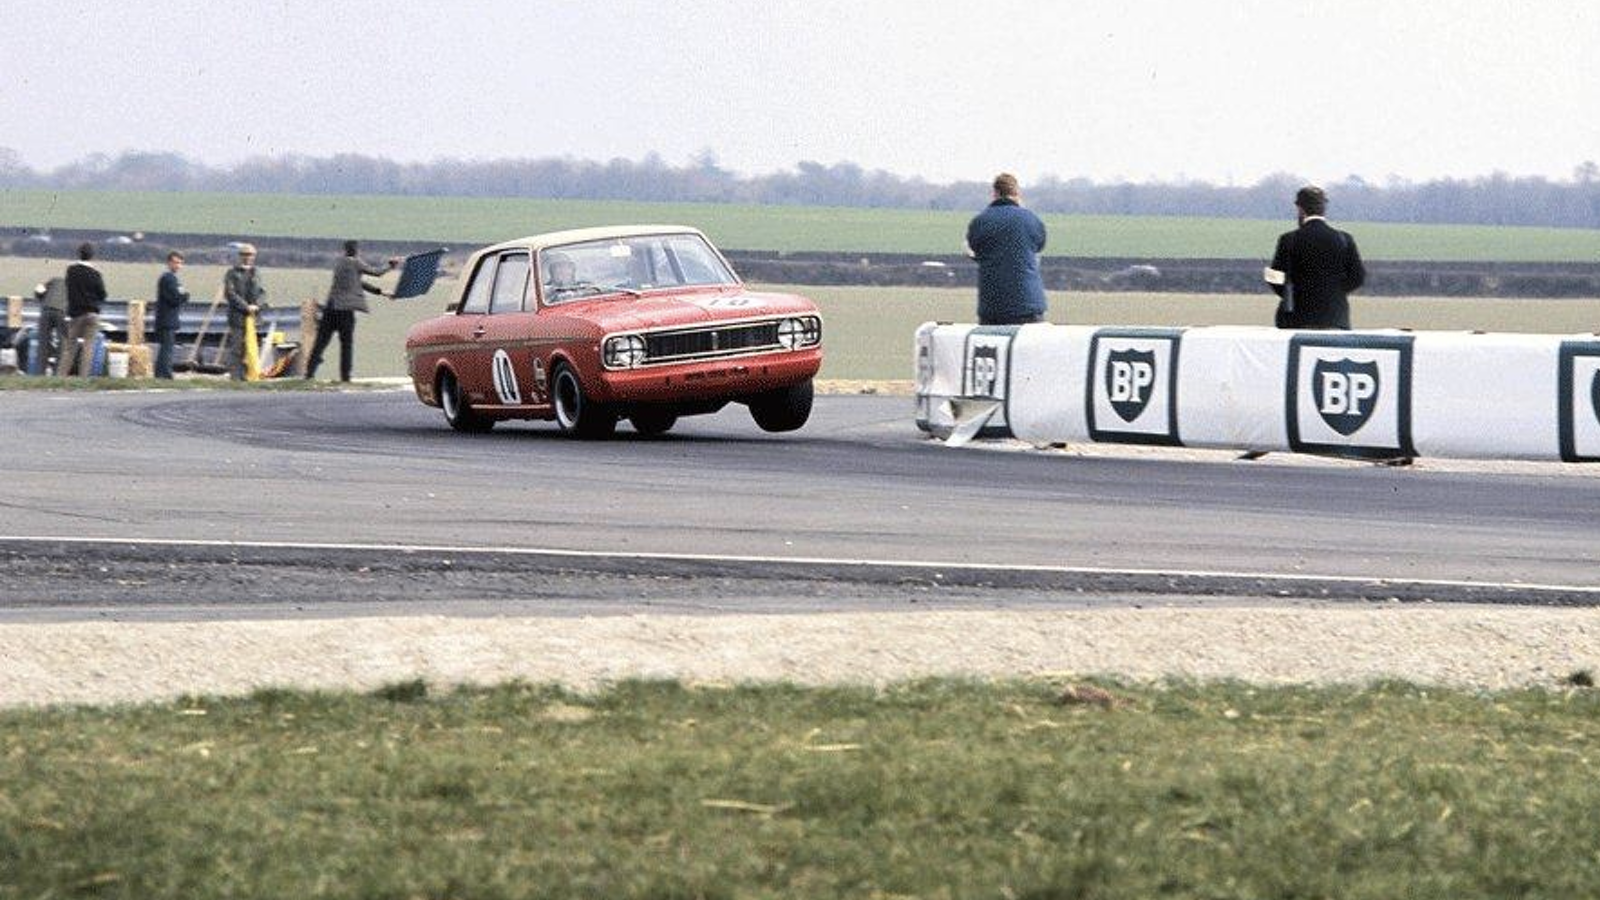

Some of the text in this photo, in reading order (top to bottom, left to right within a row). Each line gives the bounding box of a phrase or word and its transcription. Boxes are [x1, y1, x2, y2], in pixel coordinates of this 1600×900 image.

[495, 357, 517, 401] 10
[974, 357, 996, 396] BP
[1111, 361, 1153, 402] BP
[1321, 371, 1376, 415] BP
